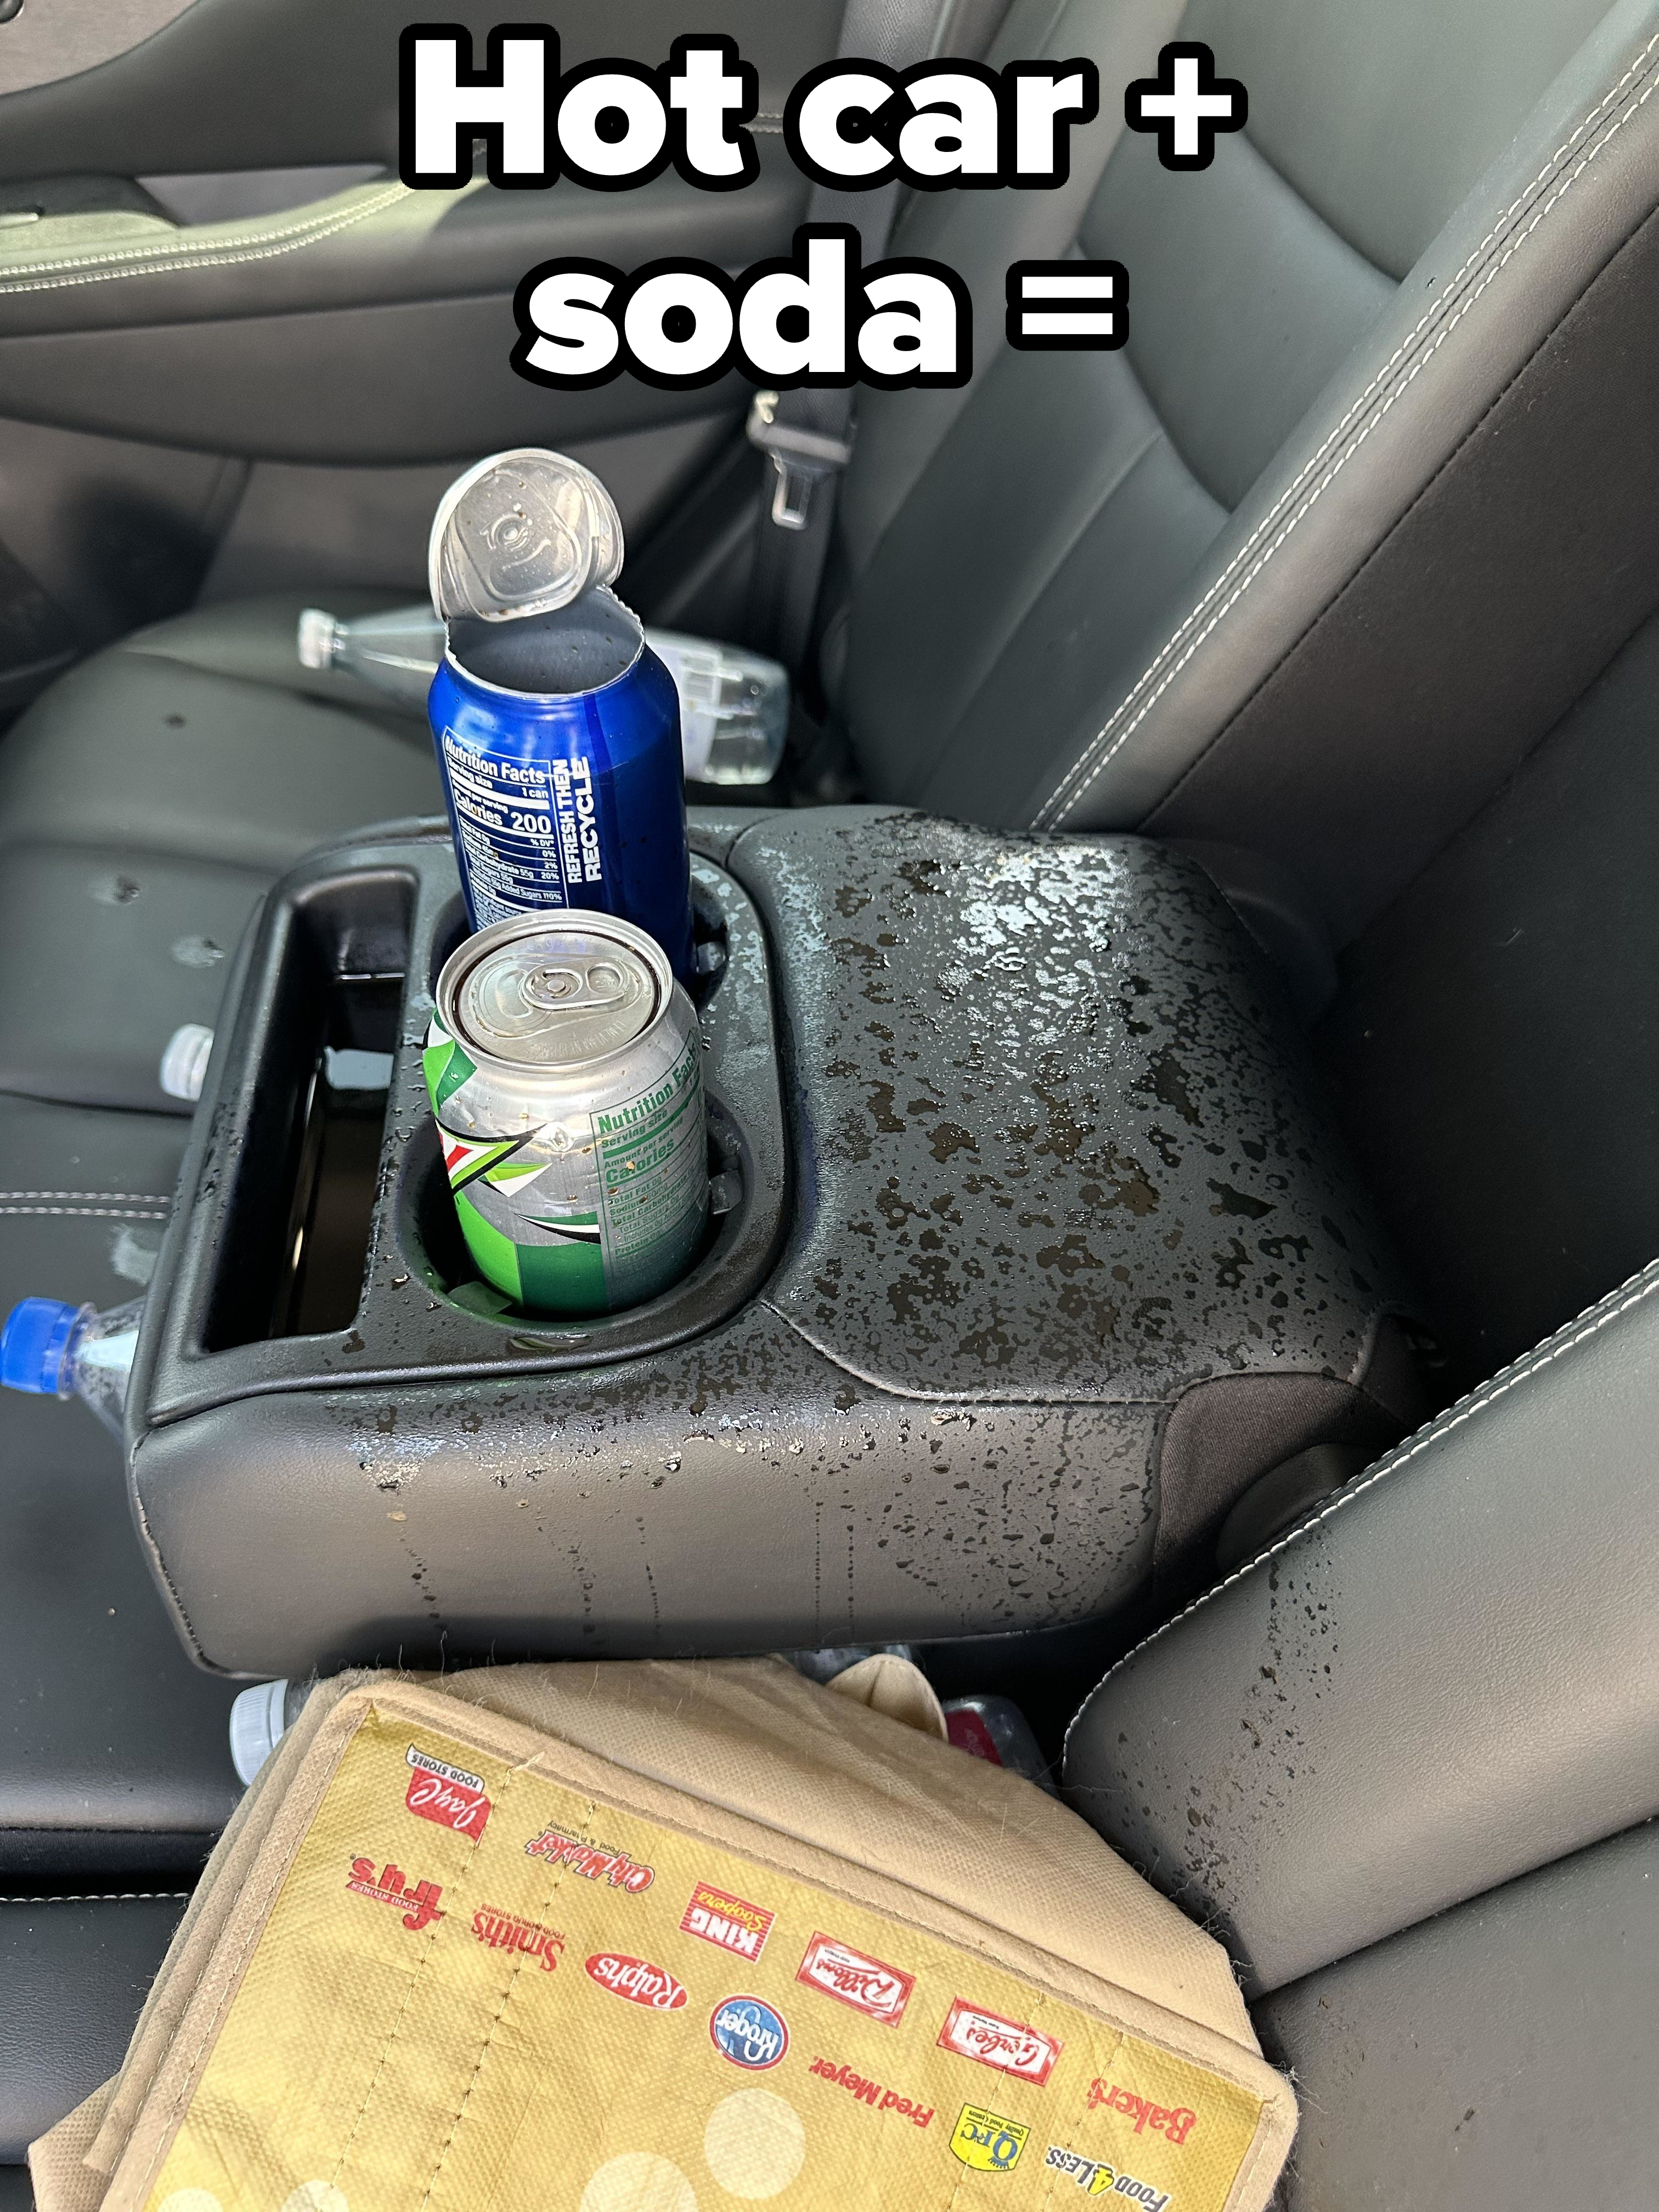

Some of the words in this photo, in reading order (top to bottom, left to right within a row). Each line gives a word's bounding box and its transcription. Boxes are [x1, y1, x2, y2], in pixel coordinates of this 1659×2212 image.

[445, 735, 498, 776] Nutrition
[501, 762, 545, 784] Facts
[448, 757, 475, 783] Serving
[475, 774, 493, 789] size
[522, 787, 527, 797] 1
[529, 789, 549, 798] can
[552, 759, 573, 809] THEN
[454, 788, 503, 826] Calories
[510, 812, 551, 833] 200
[482, 798, 509, 814] serving
[571, 756, 602, 882] RECYCLE
[476, 850, 520, 874] Carbohydrate
[520, 868, 534, 880] 55g
[541, 872, 560, 880] 20%
[544, 860, 558, 870] 2%
[558, 810, 583, 883] REFRESH
[501, 872, 514, 884] 55g
[501, 882, 520, 895] Added
[520, 888, 542, 900] Sugars
[543, 891, 562, 900] 110%
[597, 1082, 674, 1134] Nutrition
[601, 1125, 646, 1148] Serving
[648, 1108, 668, 1128] size
[604, 1150, 640, 1169] Amount
[642, 1139, 656, 1154] per
[658, 1116, 684, 1143] serving
[605, 1138, 674, 1183] Calories
[608, 1192, 633, 1205] Total
[636, 1183, 650, 1196] Fat
[652, 1176, 662, 1187] 0g
[610, 1199, 642, 1216] Sodium
[611, 1211, 635, 1227] Total
[637, 1175, 687, 1216] Carbohydrate
[618, 1220, 640, 1234] Total
[642, 1204, 669, 1224] Sugars
[670, 1194, 680, 1205] 0g
[624, 1224, 653, 1243] Includes
[654, 1218, 663, 1228] 0g
[664, 1203, 681, 1221] Added
[614, 1238, 648, 1256] Protein
[650, 1229, 661, 1239] 0g
[411, 1753, 449, 1775] STORES
[450, 1769, 479, 1789] FOOD
[548, 1820, 587, 1843] Pharmacy
[589, 1838, 596, 1846] &
[600, 1842, 621, 1857] Food
[524, 1829, 616, 1880] Market
[605, 1852, 655, 1893] City
[351, 1882, 390, 1901] STORES
[391, 1897, 420, 1912] FOOD
[697, 1889, 768, 1933] Soopers
[481, 1903, 512, 1920] STORES
[512, 1915, 535, 1928] DRUG
[689, 1907, 760, 1955] KING
[471, 1912, 566, 1972] Smith's
[543, 1927, 566, 1940] FOOD
[593, 1956, 684, 2008] Ralphs
[816, 1957, 895, 2007] Dillons
[715, 2006, 779, 2061] Kroger
[966, 2025, 1040, 2067] Gerbes
[808, 2058, 882, 2106] Meyer
[877, 2091, 935, 2129] Fred
[989, 2118, 1003, 2129] Food
[1087, 2077, 1197, 2146] Baker's
[960, 2123, 1018, 2161] QFC
[1005, 2123, 1024, 2137] Quality
[1087, 2163, 1115, 2196] 4
[1114, 2175, 1169, 2212] FOOD
